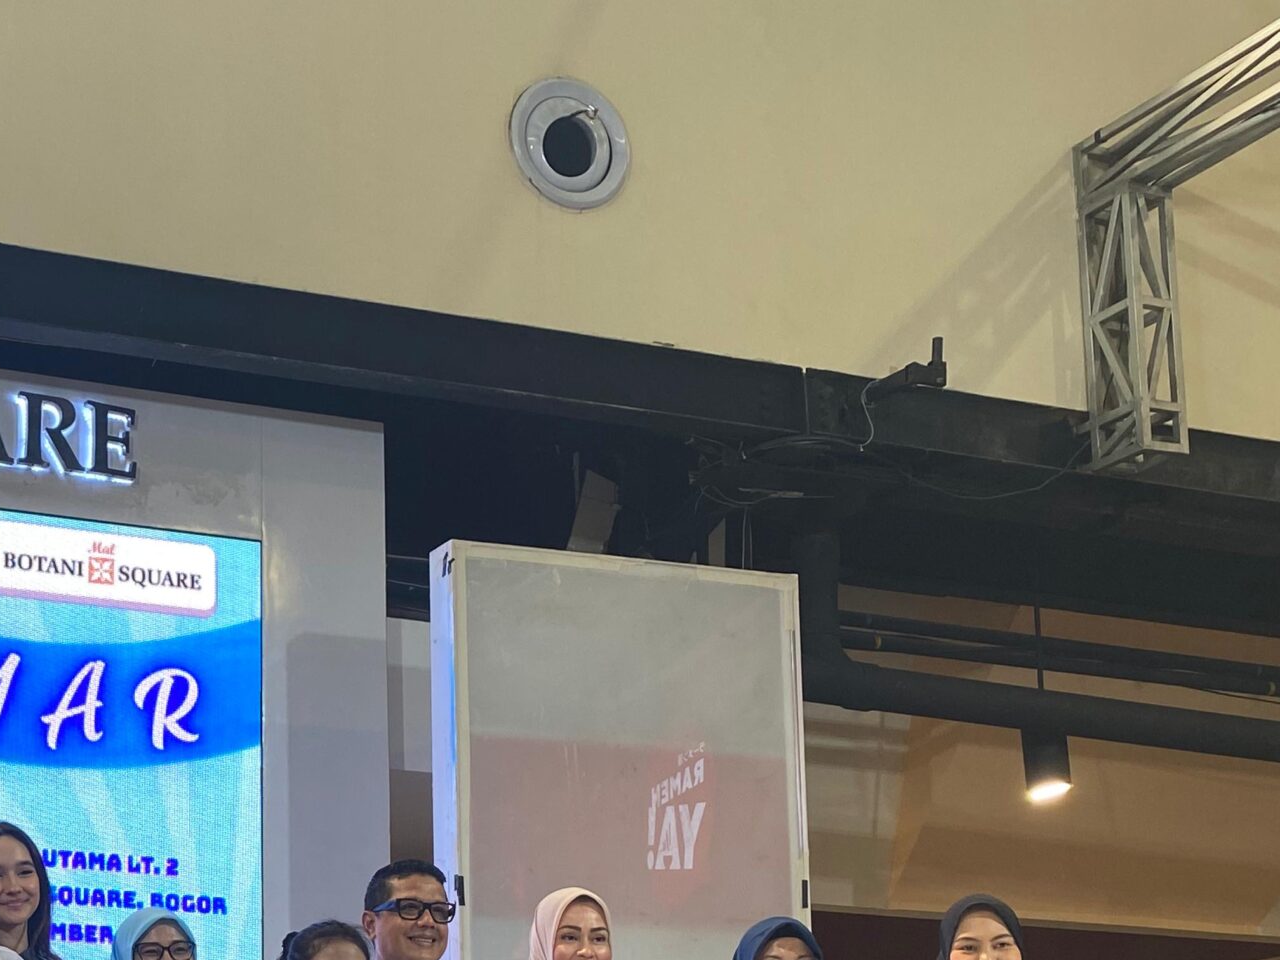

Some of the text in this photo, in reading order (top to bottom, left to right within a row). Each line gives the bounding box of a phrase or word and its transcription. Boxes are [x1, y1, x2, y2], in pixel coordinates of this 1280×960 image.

[88, 541, 115, 555] Mal
[3, 552, 202, 591] BOTANI SQUARE
[42, 849, 124, 871] UTAMA
[165, 858, 179, 876] 2
[150, 892, 228, 915] BOGOR
[50, 923, 113, 944] MBER
